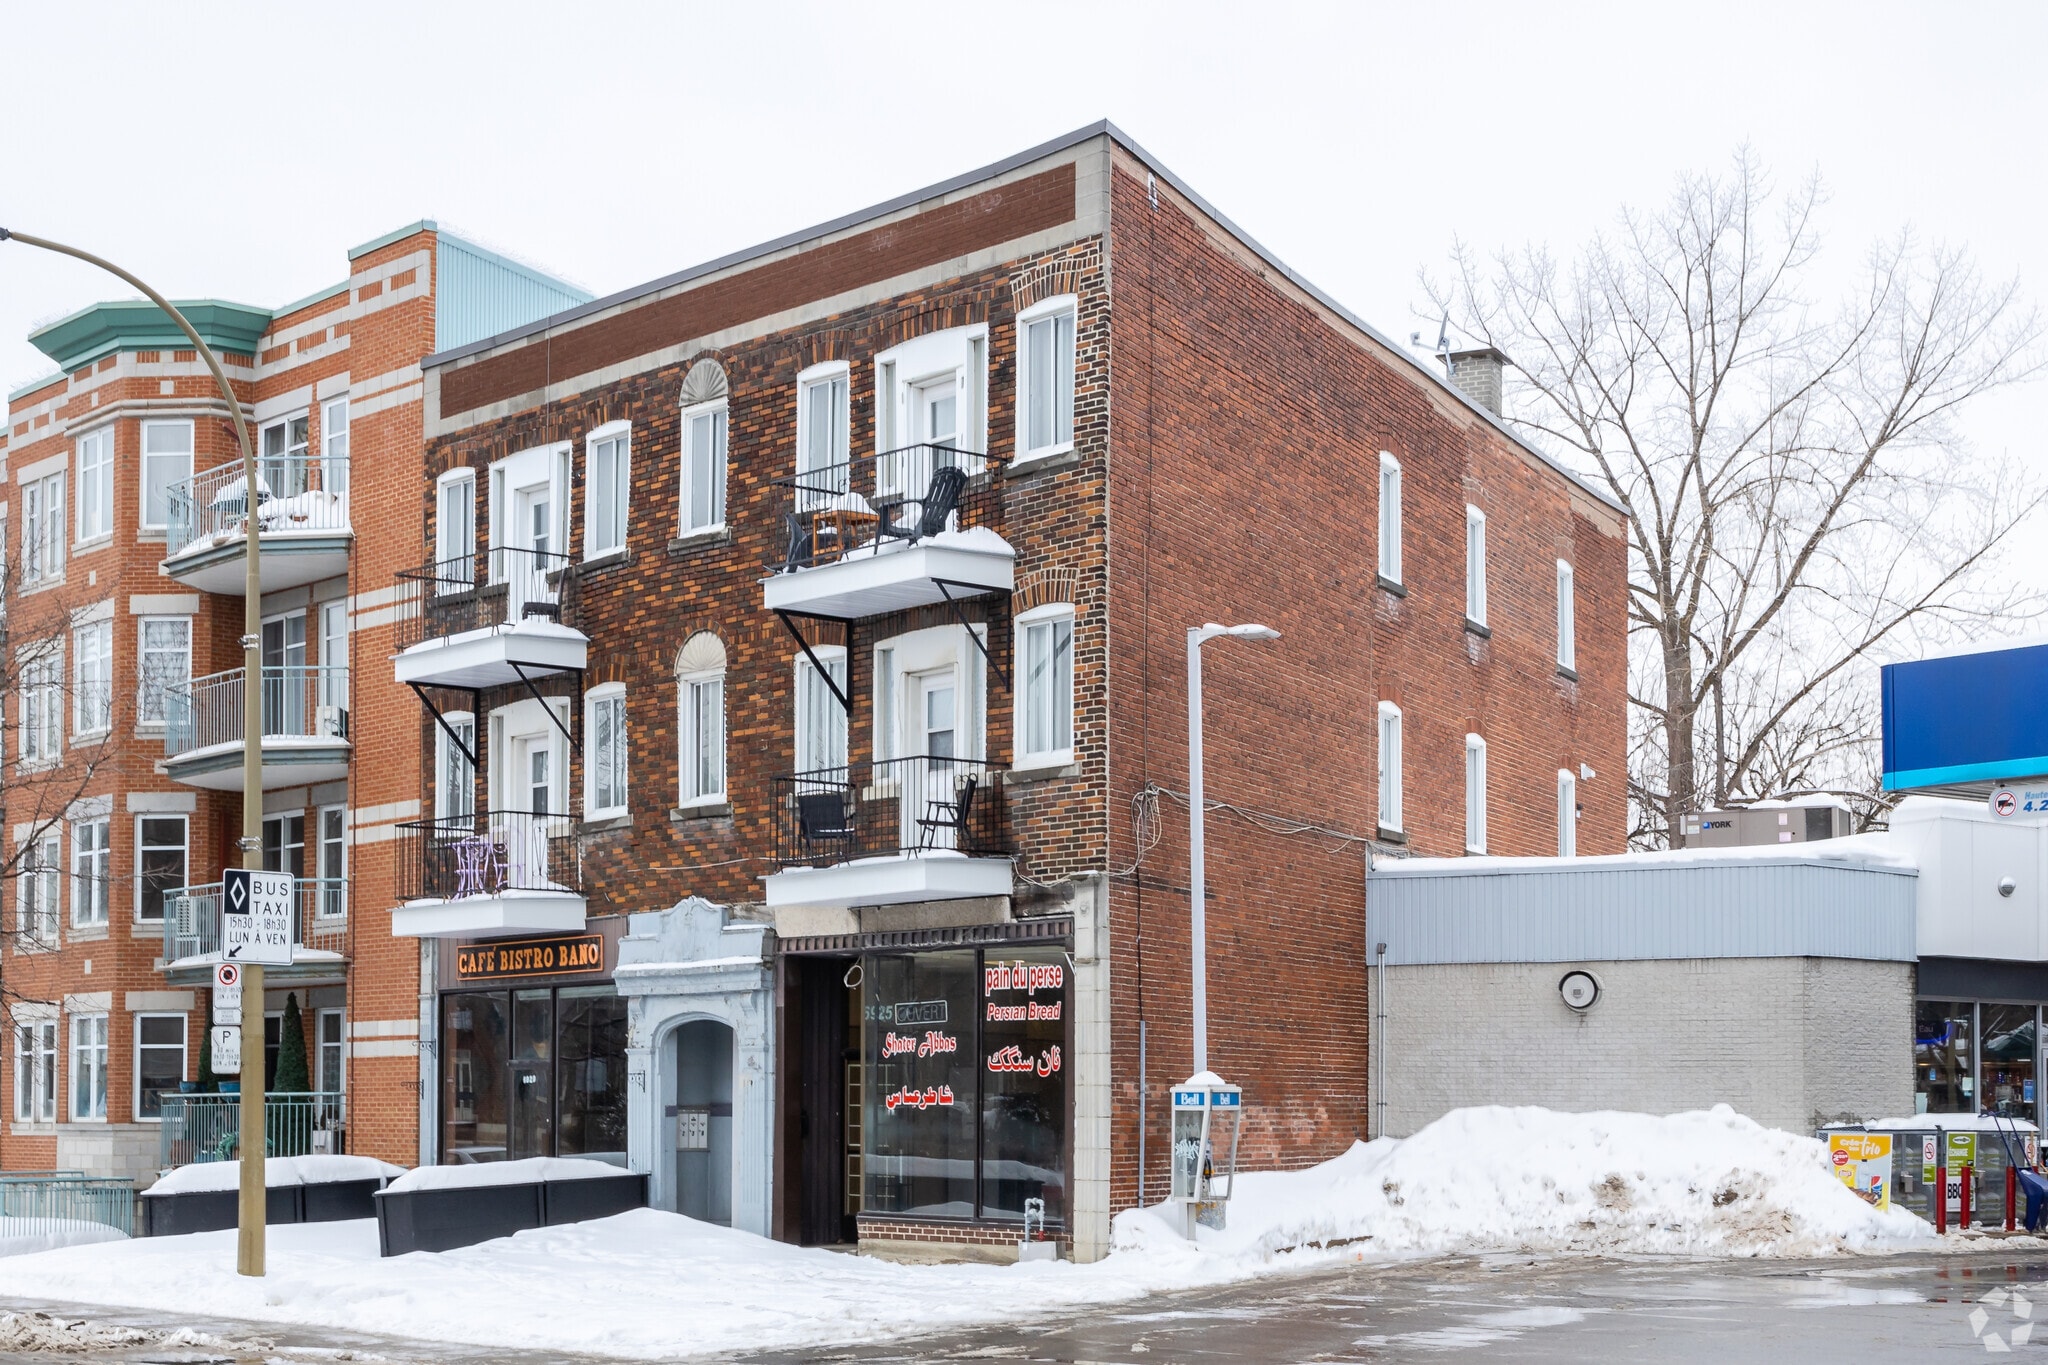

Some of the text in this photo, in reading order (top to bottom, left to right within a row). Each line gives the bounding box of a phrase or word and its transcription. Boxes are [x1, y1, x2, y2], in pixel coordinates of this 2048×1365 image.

[1710, 821, 1732, 829] YORK
[253, 881, 288, 896] BUS
[253, 901, 288, 916] TAXI
[230, 916, 252, 929] 15h30
[263, 918, 286, 931] 18h30
[230, 929, 286, 945] LUN À VEN
[459, 943, 599, 973] CAFÉ BISTRO BANO
[985, 960, 1063, 996] pain du perse
[897, 1003, 946, 1022] OUVERT
[987, 1001, 1061, 1021] Persian Bread
[223, 1031, 231, 1043] P
[882, 1031, 956, 1058] Shater Abbas
[1037, 1045, 1061, 1077] نان
[1181, 1093, 1199, 1105] Bell
[1220, 1093, 1230, 1105] Bell
